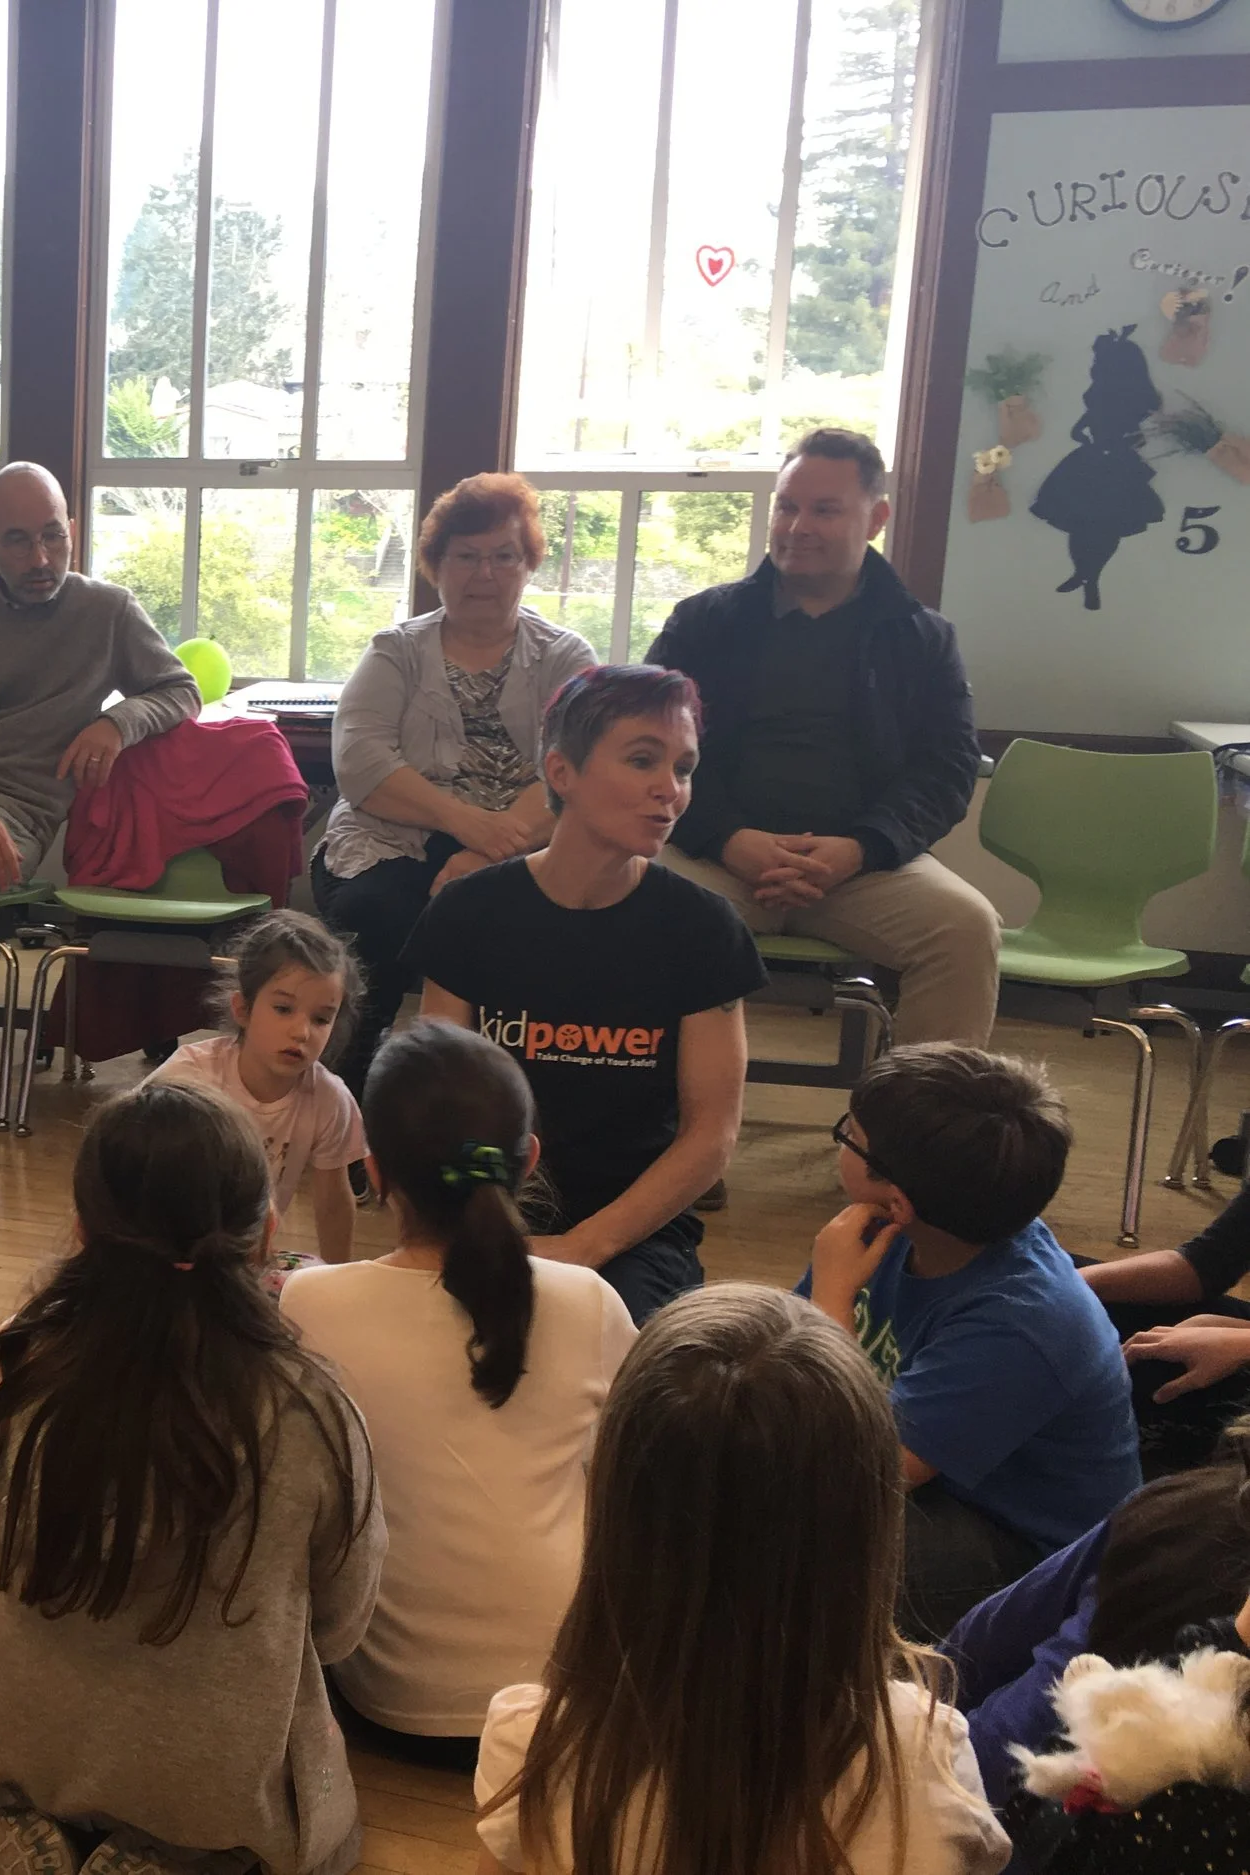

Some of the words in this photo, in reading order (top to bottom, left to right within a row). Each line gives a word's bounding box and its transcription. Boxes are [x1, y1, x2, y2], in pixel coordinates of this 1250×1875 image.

[978, 169, 1250, 248] CURIOUS
[1175, 505, 1221, 555] 5
[478, 1005, 665, 1060] kidpower
[536, 1053, 558, 1061] Take
[559, 1054, 593, 1065] Charge
[606, 1058, 629, 1066] Your
